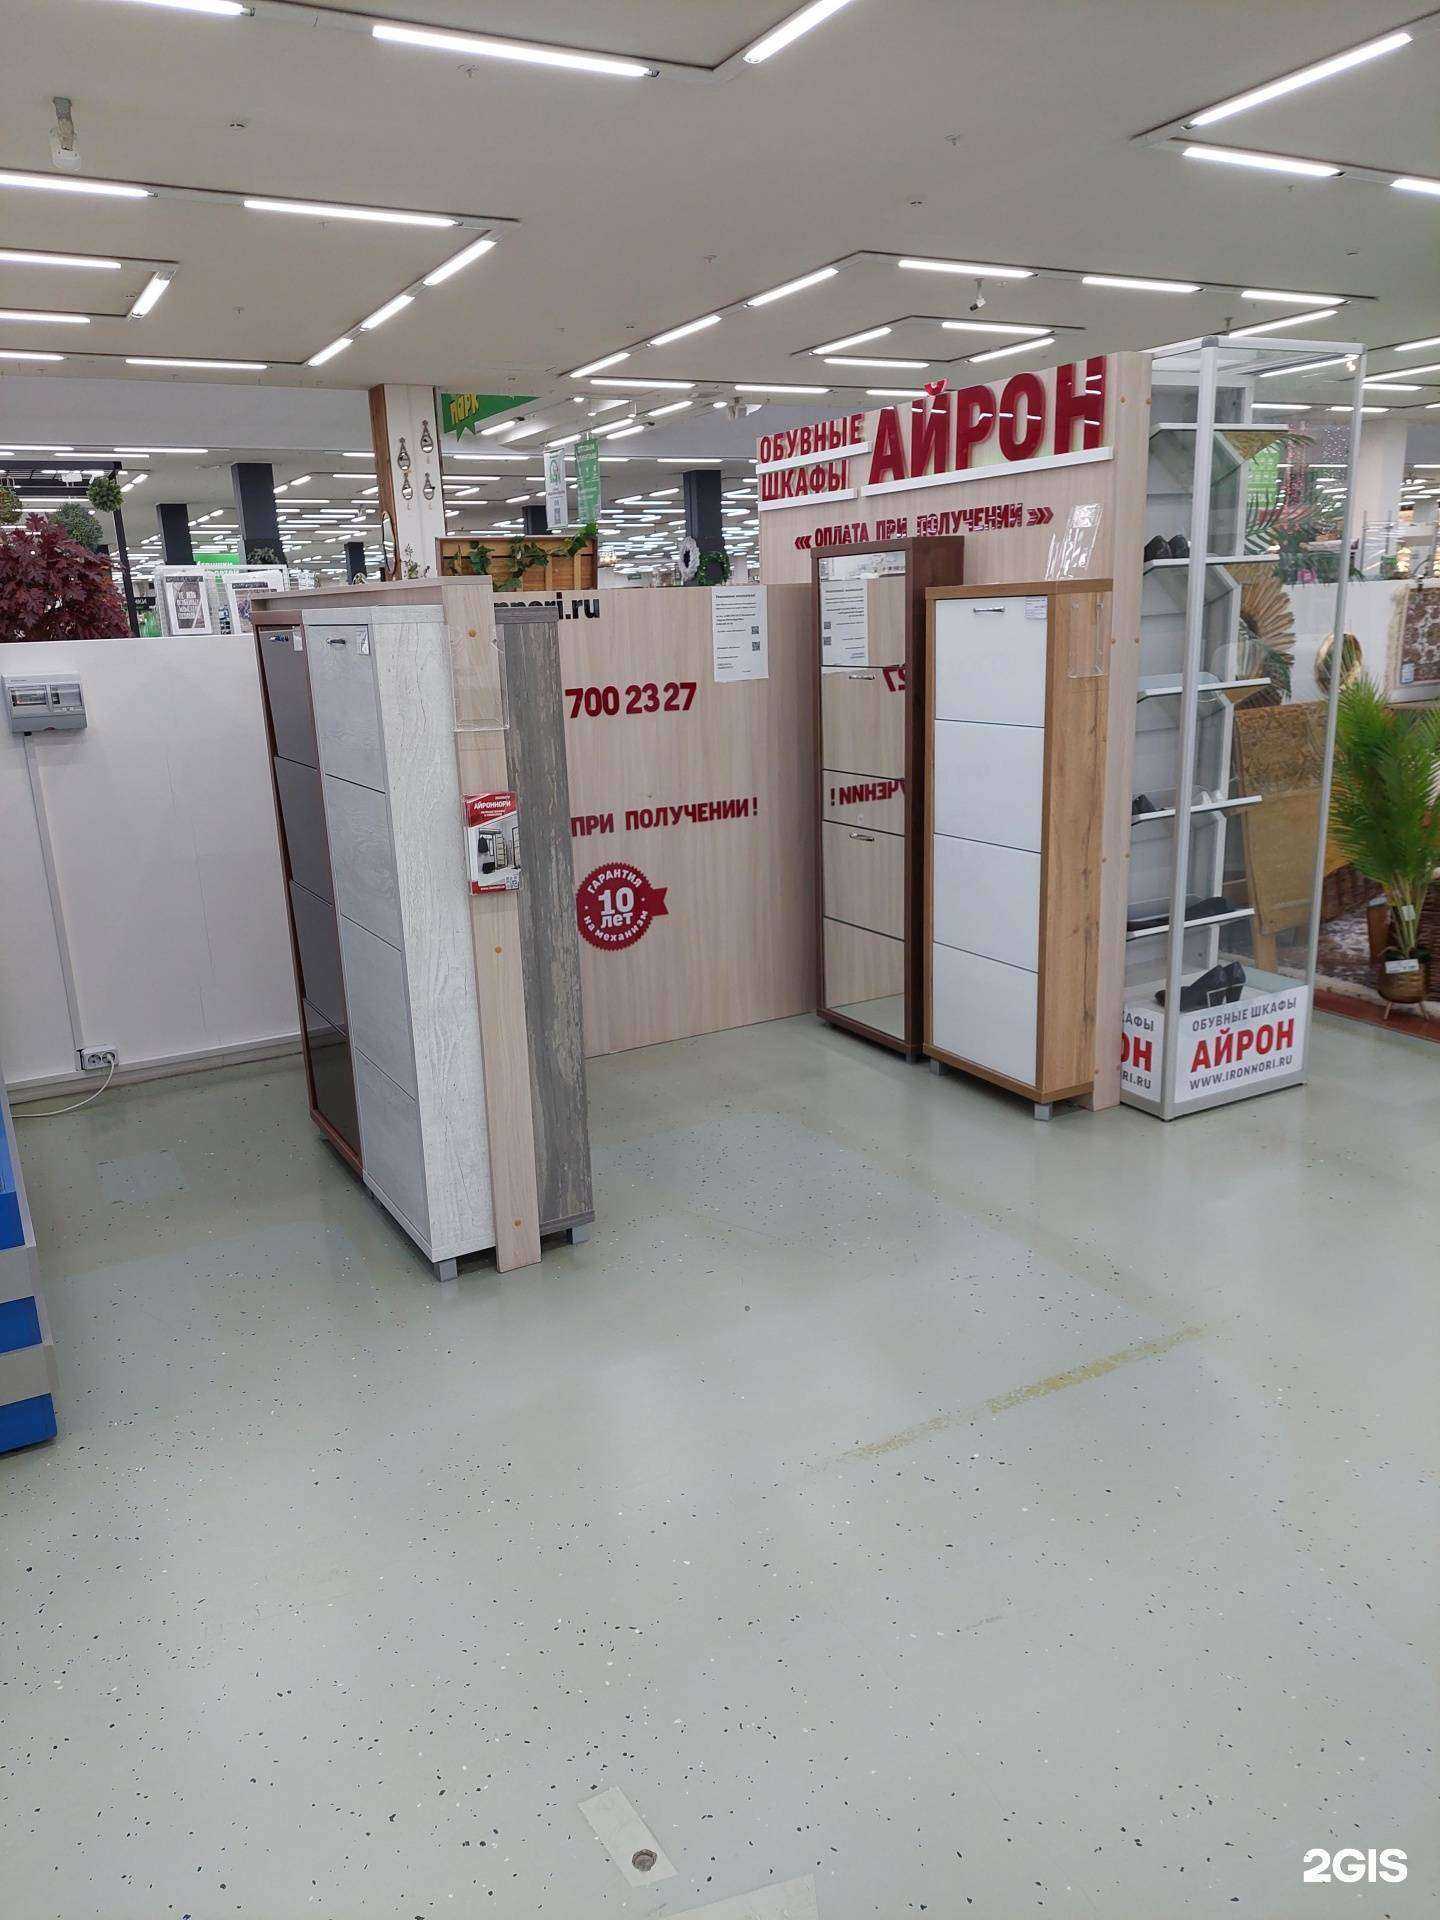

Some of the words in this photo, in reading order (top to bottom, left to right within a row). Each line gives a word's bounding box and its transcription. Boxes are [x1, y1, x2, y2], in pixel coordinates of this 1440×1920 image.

[869, 355, 1107, 485] АЙРОН
[760, 413, 865, 464] ОБУВНЫЕ
[762, 460, 847, 501] ШКАФЫ
[876, 517, 908, 541] ПРИ
[917, 502, 1024, 537] ПОЛУЧЕНИИ
[570, 813, 614, 837] ПРИ
[587, 868, 642, 894] ГАРАНТИЯ
[598, 886, 635, 916] 10
[600, 912, 633, 929] лет
[1122, 1010, 1154, 1032] АФЫ
[1192, 1009, 1249, 1032] ОБУВНЫЕ
[1251, 998, 1297, 1019] ШКАФЫ
[1190, 1018, 1295, 1073] АЙРОН
